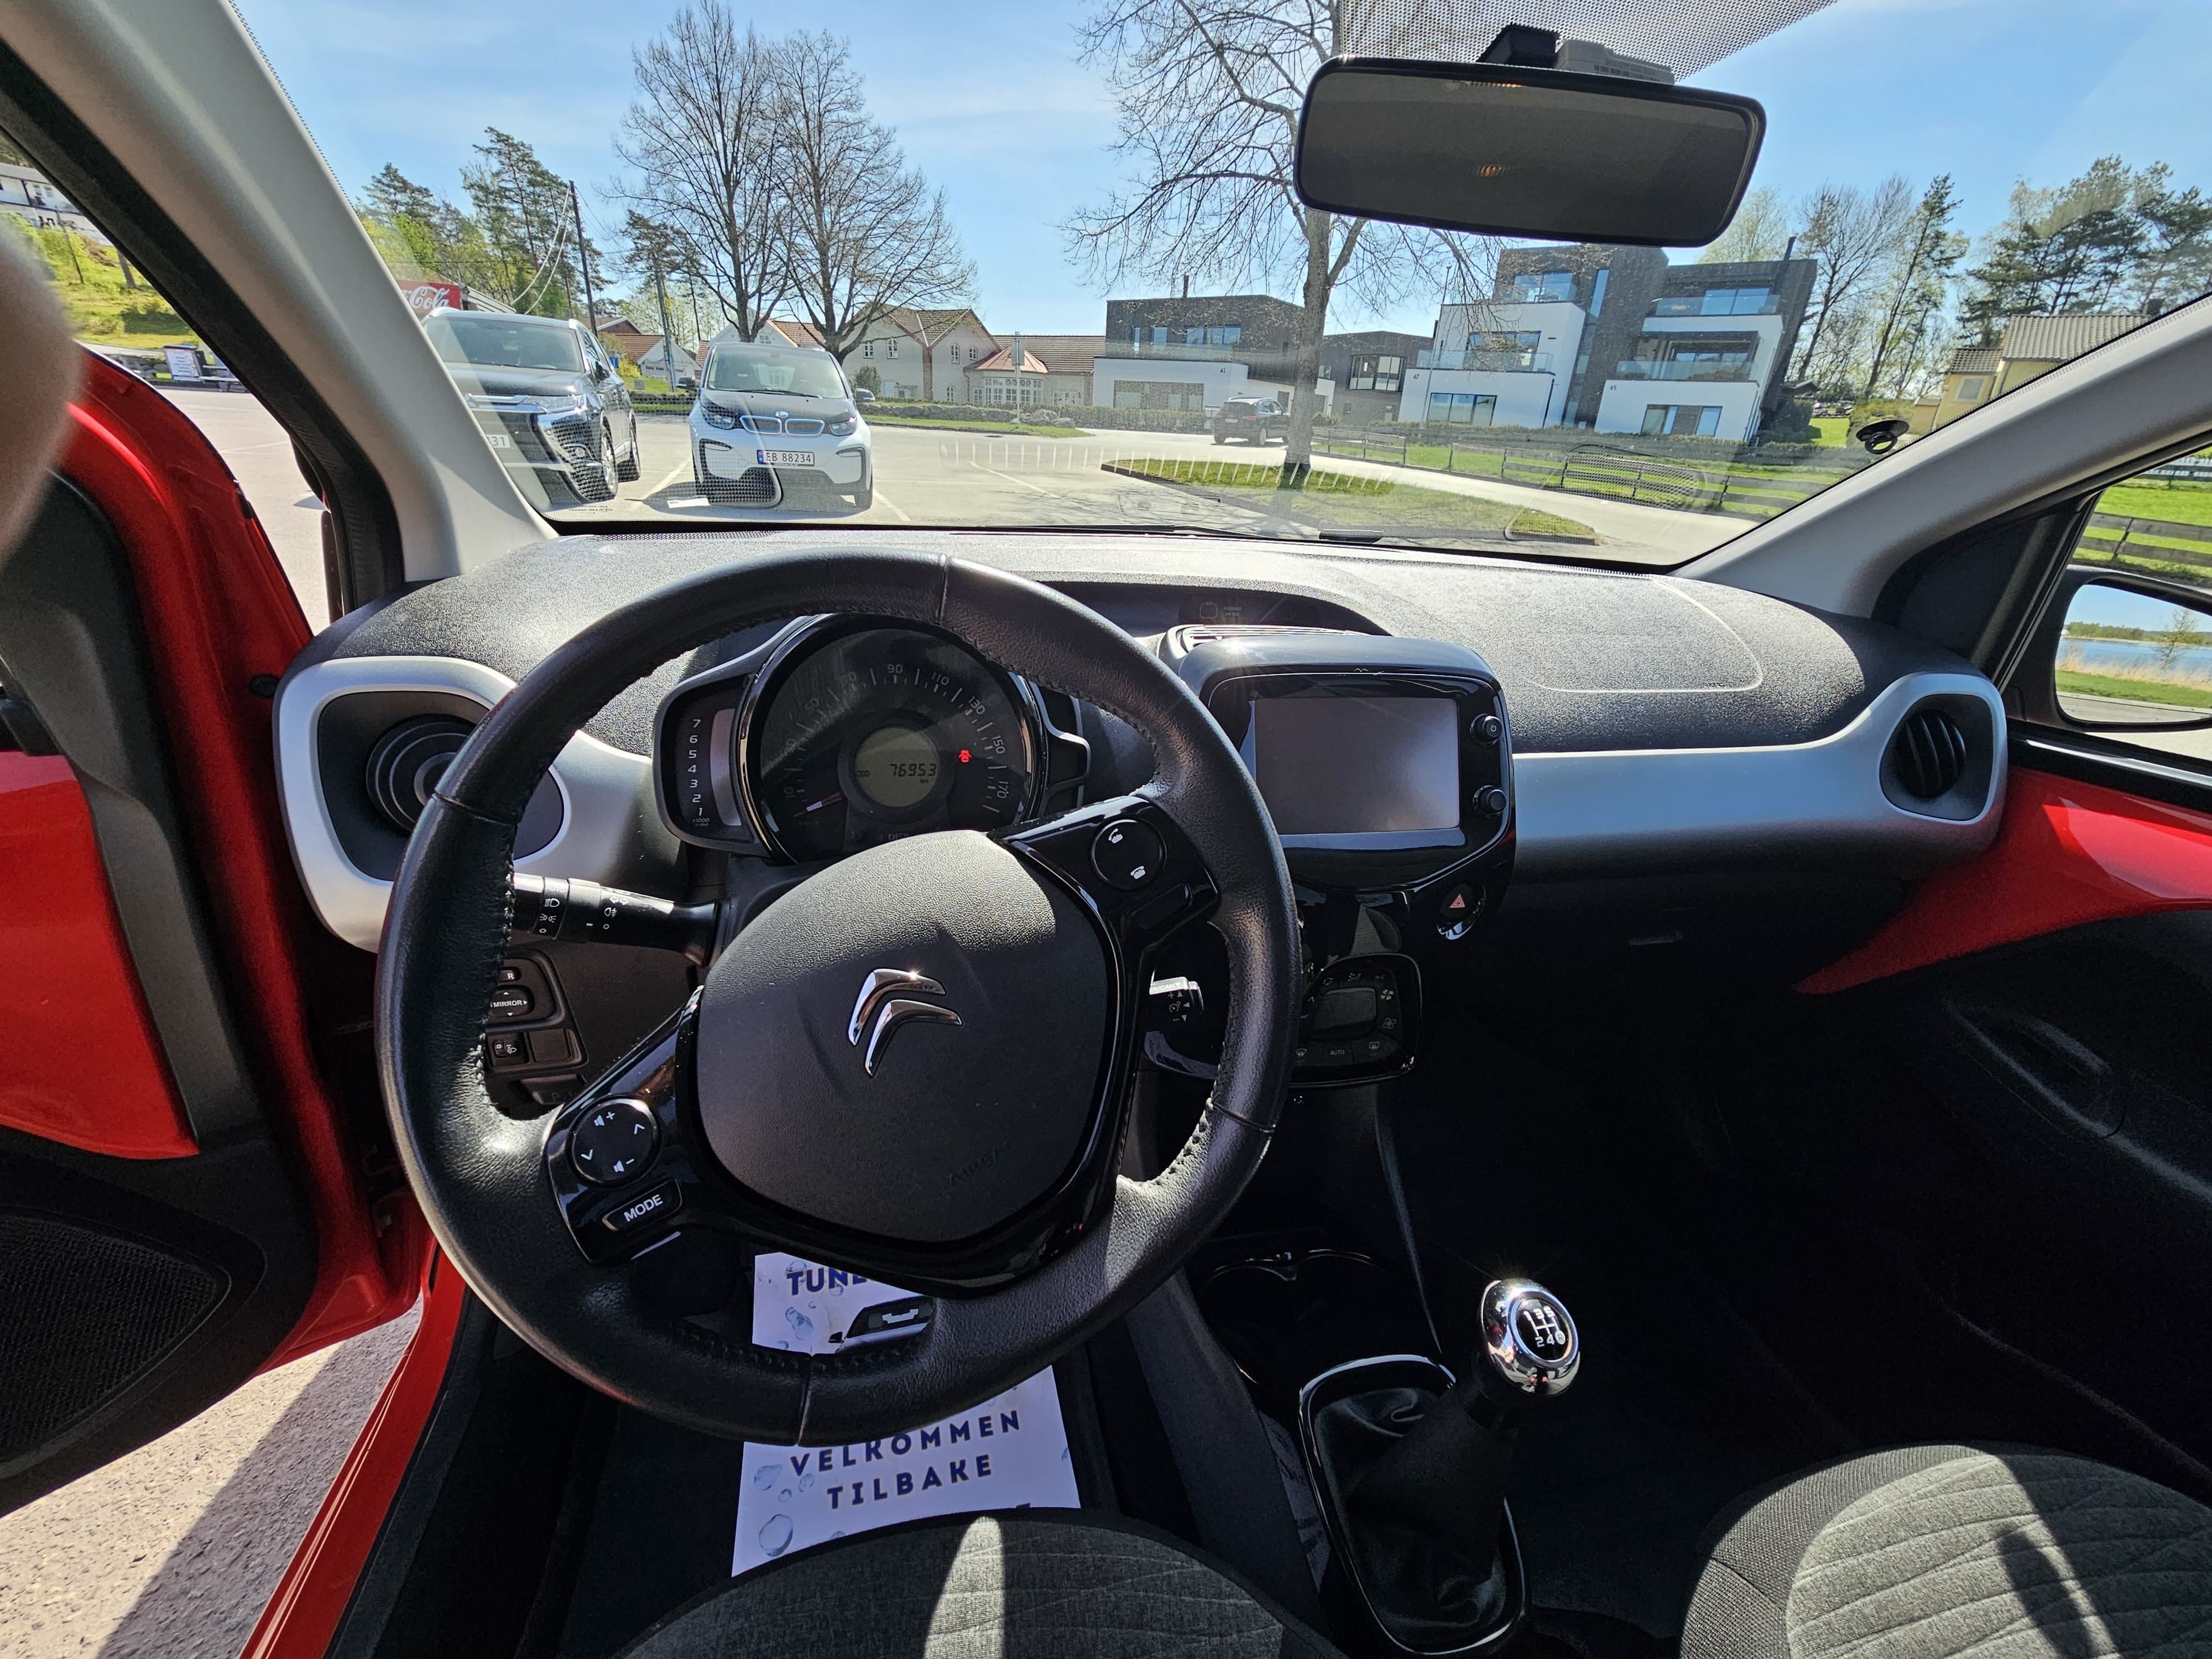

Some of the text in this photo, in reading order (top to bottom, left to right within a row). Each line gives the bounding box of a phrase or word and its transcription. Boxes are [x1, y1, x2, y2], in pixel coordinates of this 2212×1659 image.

[766, 452, 811, 463] EB 88234
[887, 664, 902, 674] 90
[932, 672, 950, 686] 110
[968, 696, 985, 714] 130
[692, 719, 701, 728] 7
[689, 734, 698, 744] 6
[992, 735, 1006, 754] 150
[688, 750, 697, 759] 5
[687, 764, 697, 774] 4
[890, 763, 937, 777] 76953
[690, 779, 698, 788] 3
[998, 780, 1010, 799] 170
[692, 794, 701, 803] 2
[698, 807, 703, 816] 1
[546, 884, 565, 893] AUTO
[623, 1194, 664, 1222] MODE
[1534, 1308, 1545, 1319] 3
[1543, 1306, 1556, 1318] 5
[1535, 1337, 1545, 1348] 2
[1546, 1334, 1555, 1345] 4
[790, 1409, 1020, 1477] VELKOMMEN
[826, 1453, 993, 1510] TILBAKE
